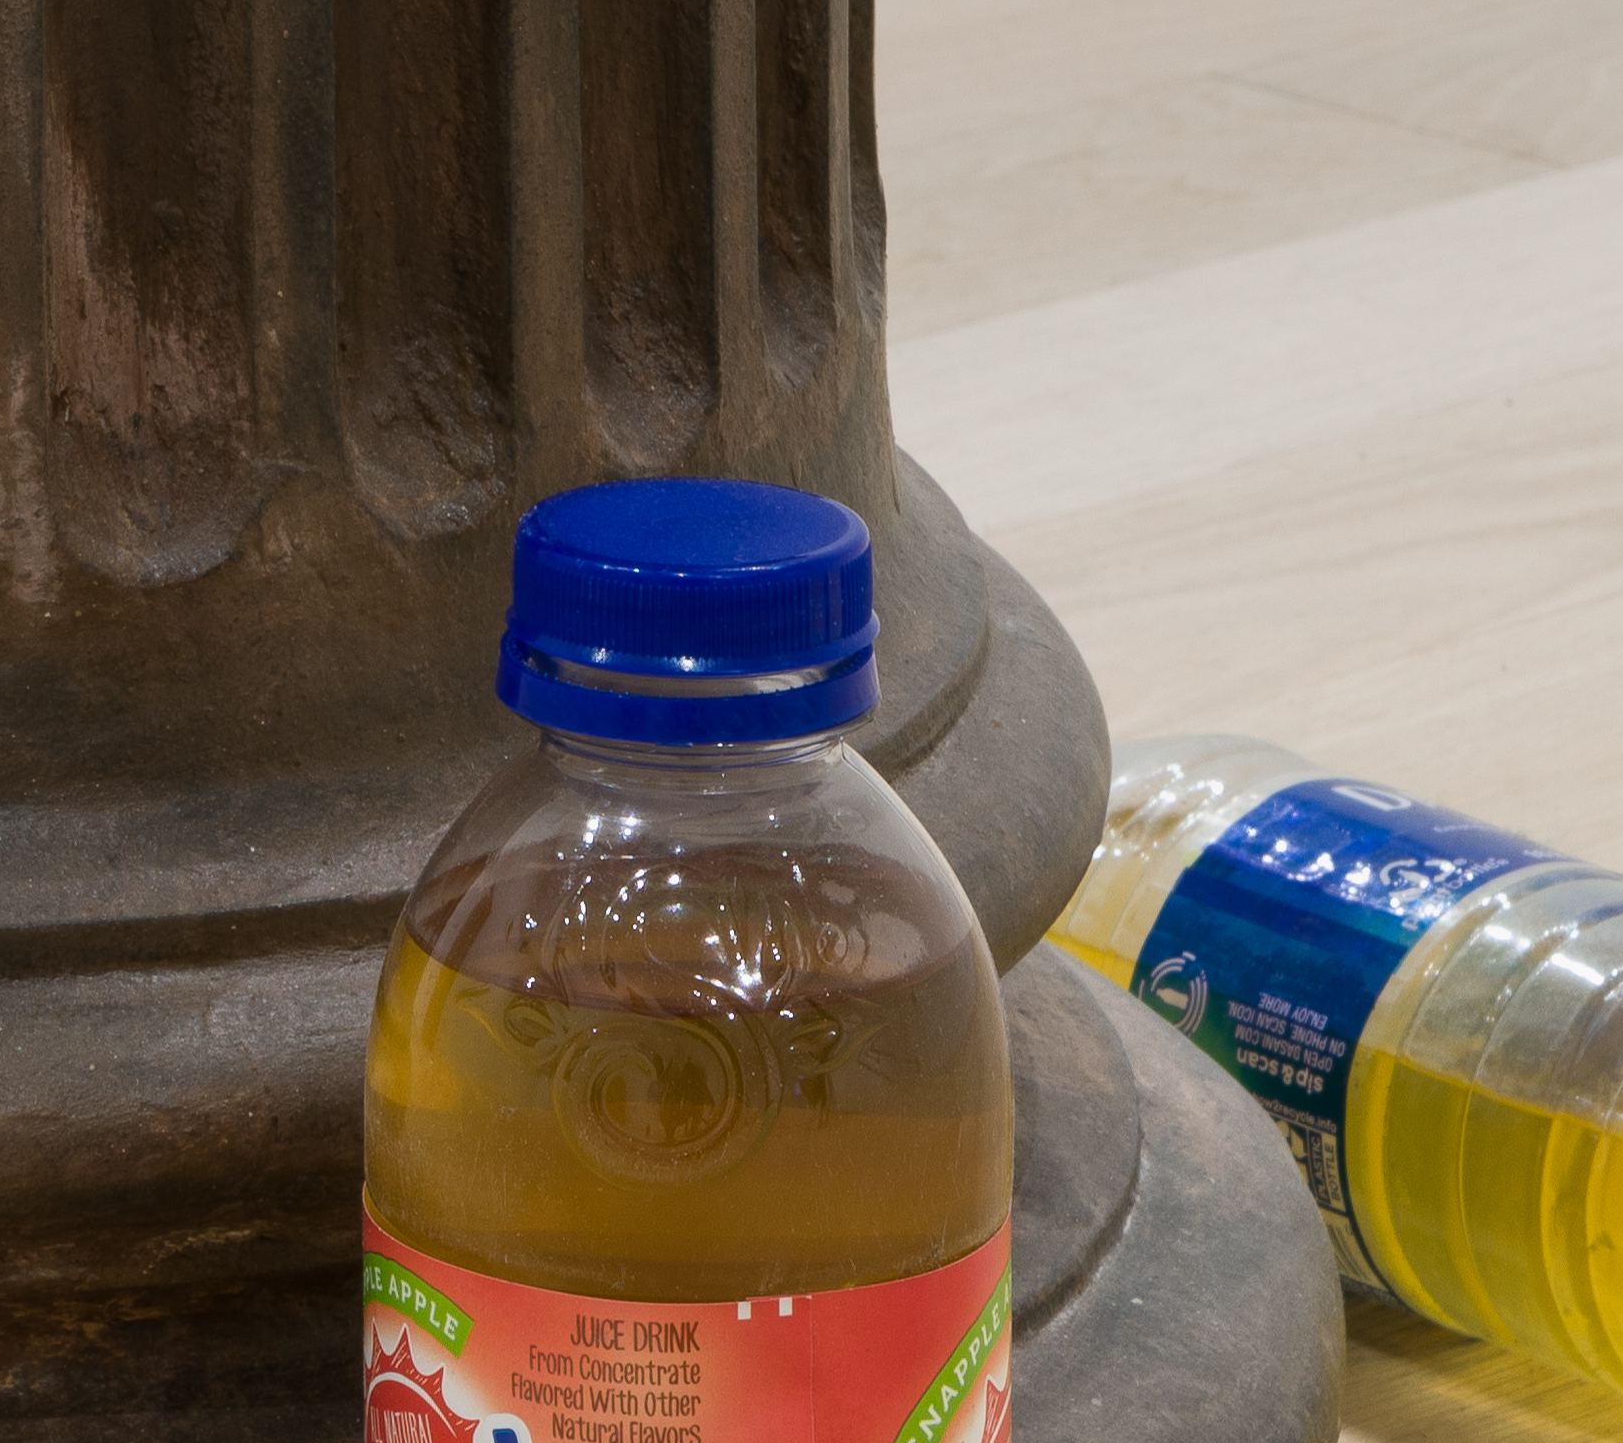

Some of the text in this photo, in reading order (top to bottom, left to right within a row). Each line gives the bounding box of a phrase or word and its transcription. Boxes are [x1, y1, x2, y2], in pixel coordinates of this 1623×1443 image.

[1255, 1011, 1287, 1035] SCAN
[1290, 1004, 1328, 1030] ENJOY
[1302, 1048, 1334, 1072] OPEN
[1327, 1038, 1346, 1057] ON
[1233, 1046, 1325, 1096] sip & scan
[388, 1273, 460, 1342] APPLE
[570, 1313, 701, 1354] JUICE DRINK
[529, 1344, 702, 1386] From Concentrate
[511, 1371, 702, 1417] Flavored With Other
